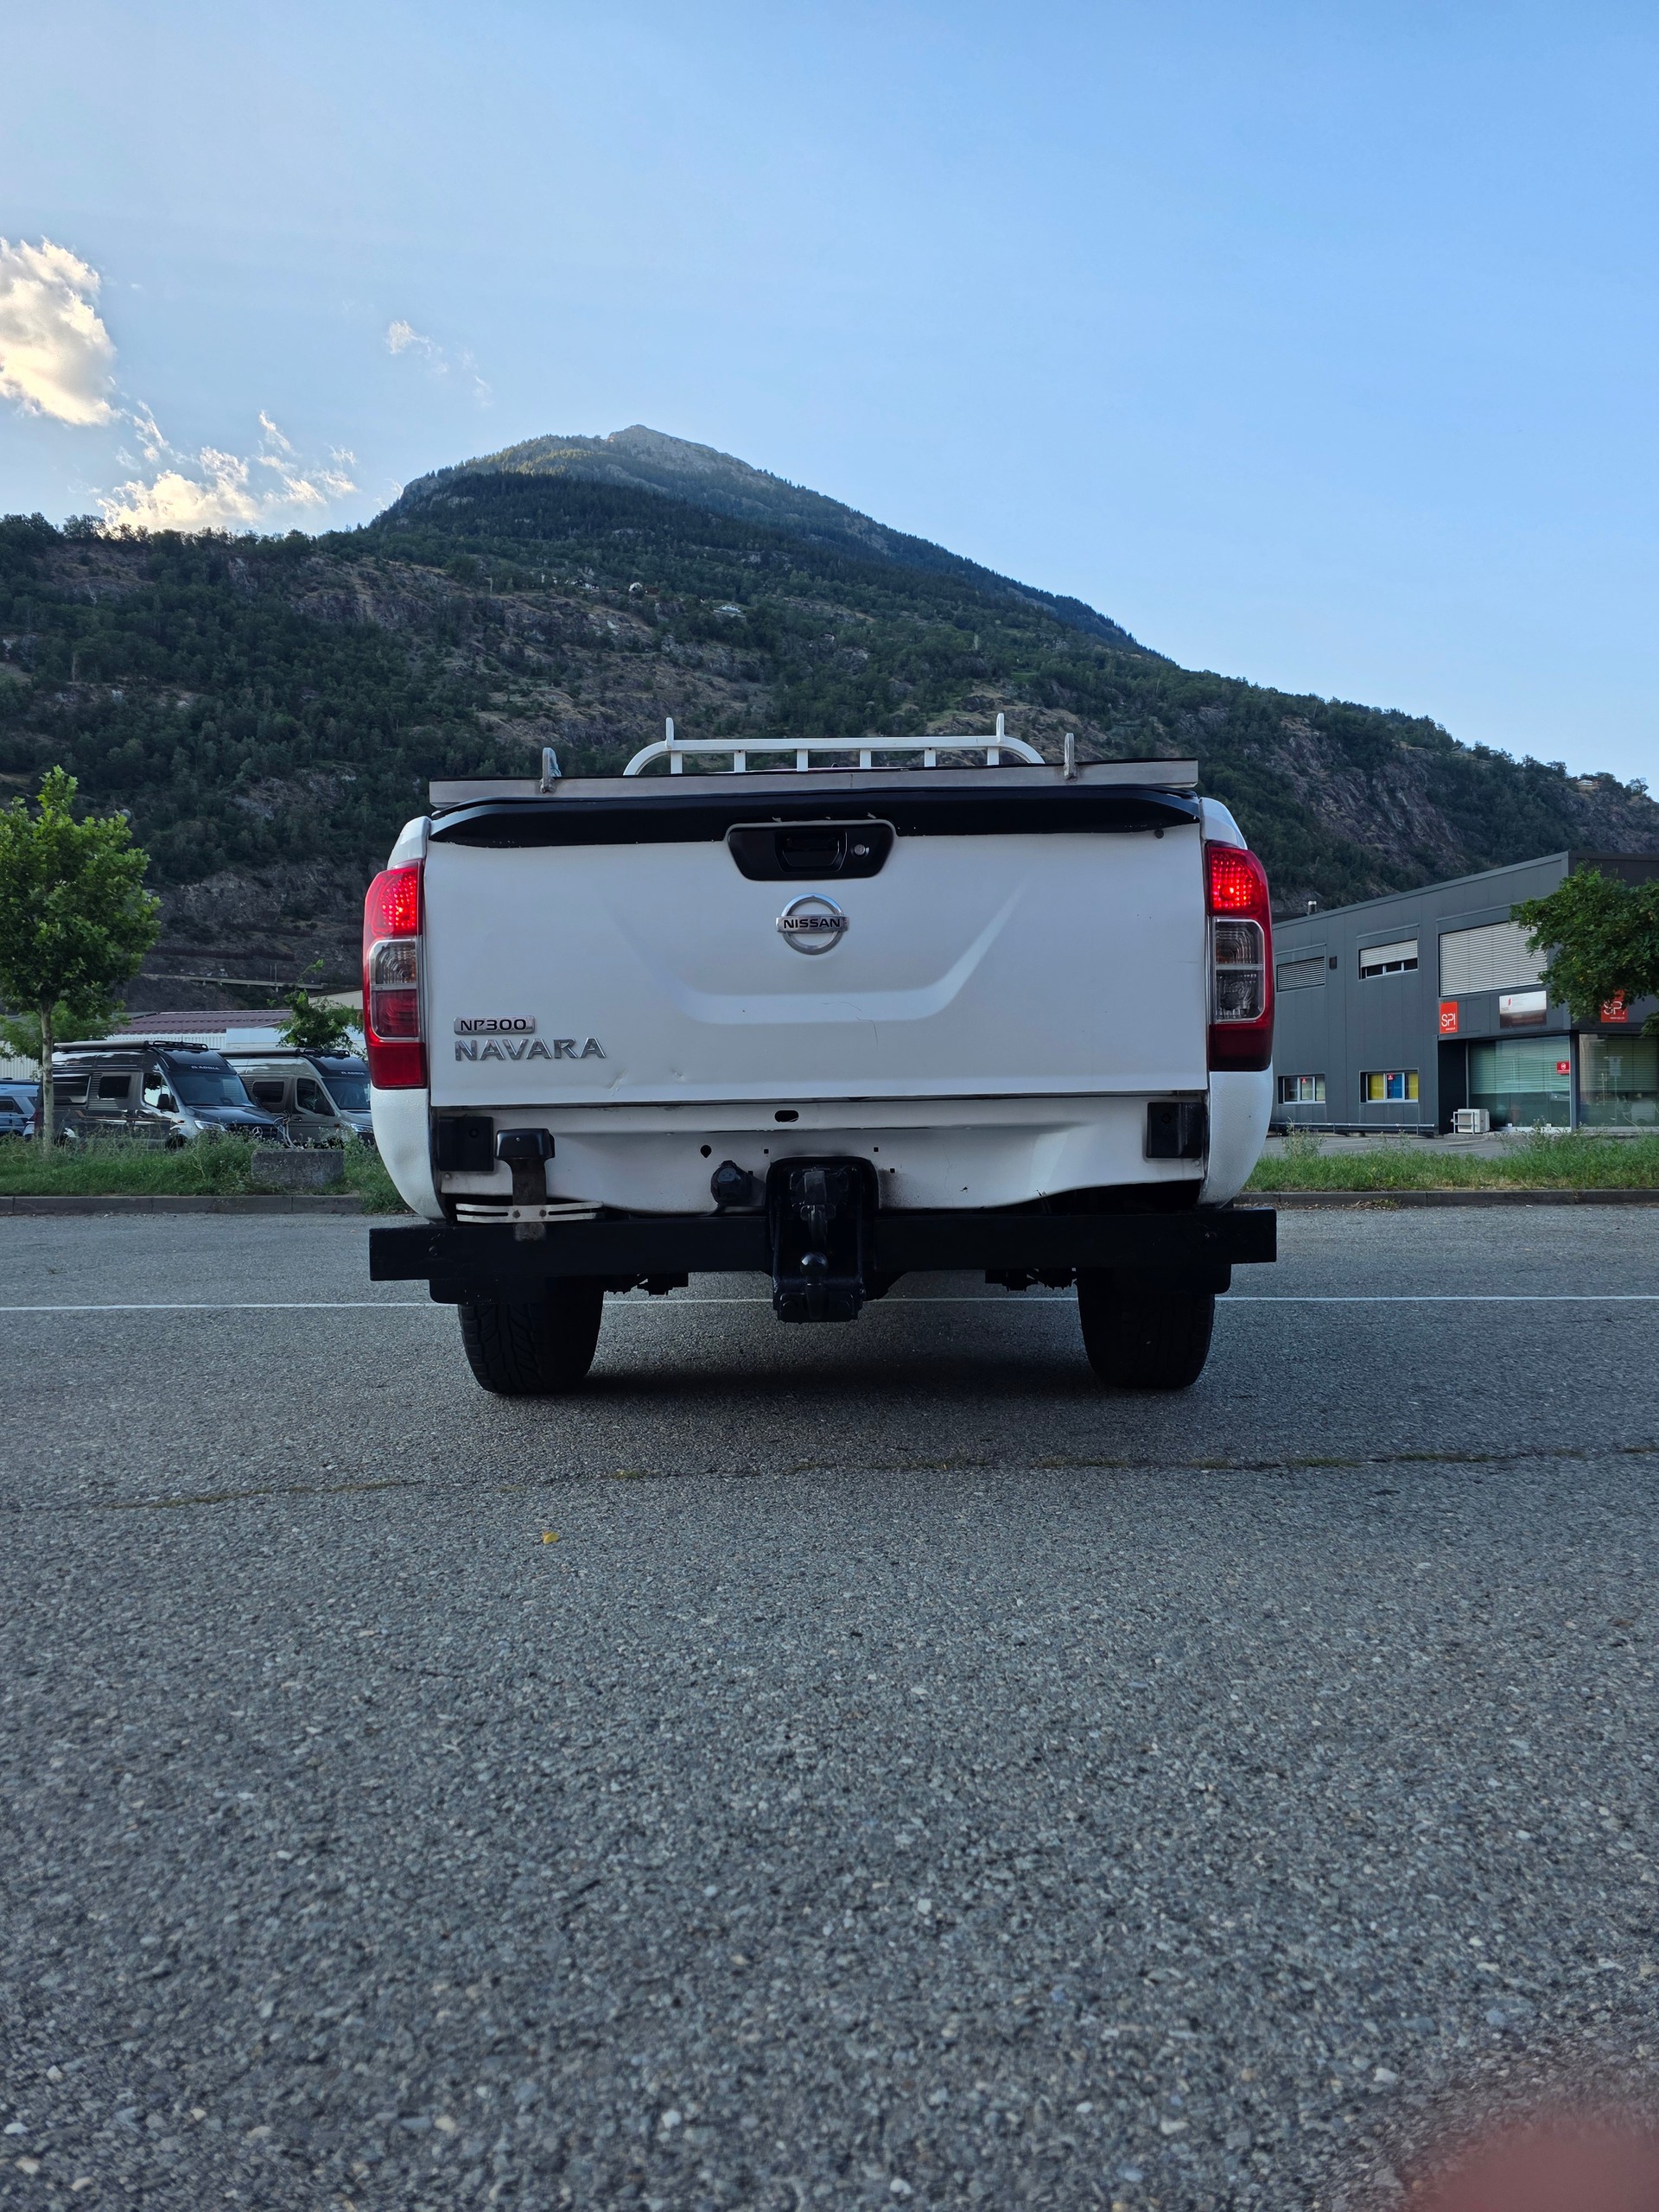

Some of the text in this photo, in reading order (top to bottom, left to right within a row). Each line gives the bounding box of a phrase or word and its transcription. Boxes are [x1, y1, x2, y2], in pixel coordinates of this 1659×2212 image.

[783, 918, 841, 929] NISSAN
[461, 1020, 527, 1031] NP300
[1441, 1013, 1456, 1027] SPI
[454, 1037, 606, 1061] NAVARA
